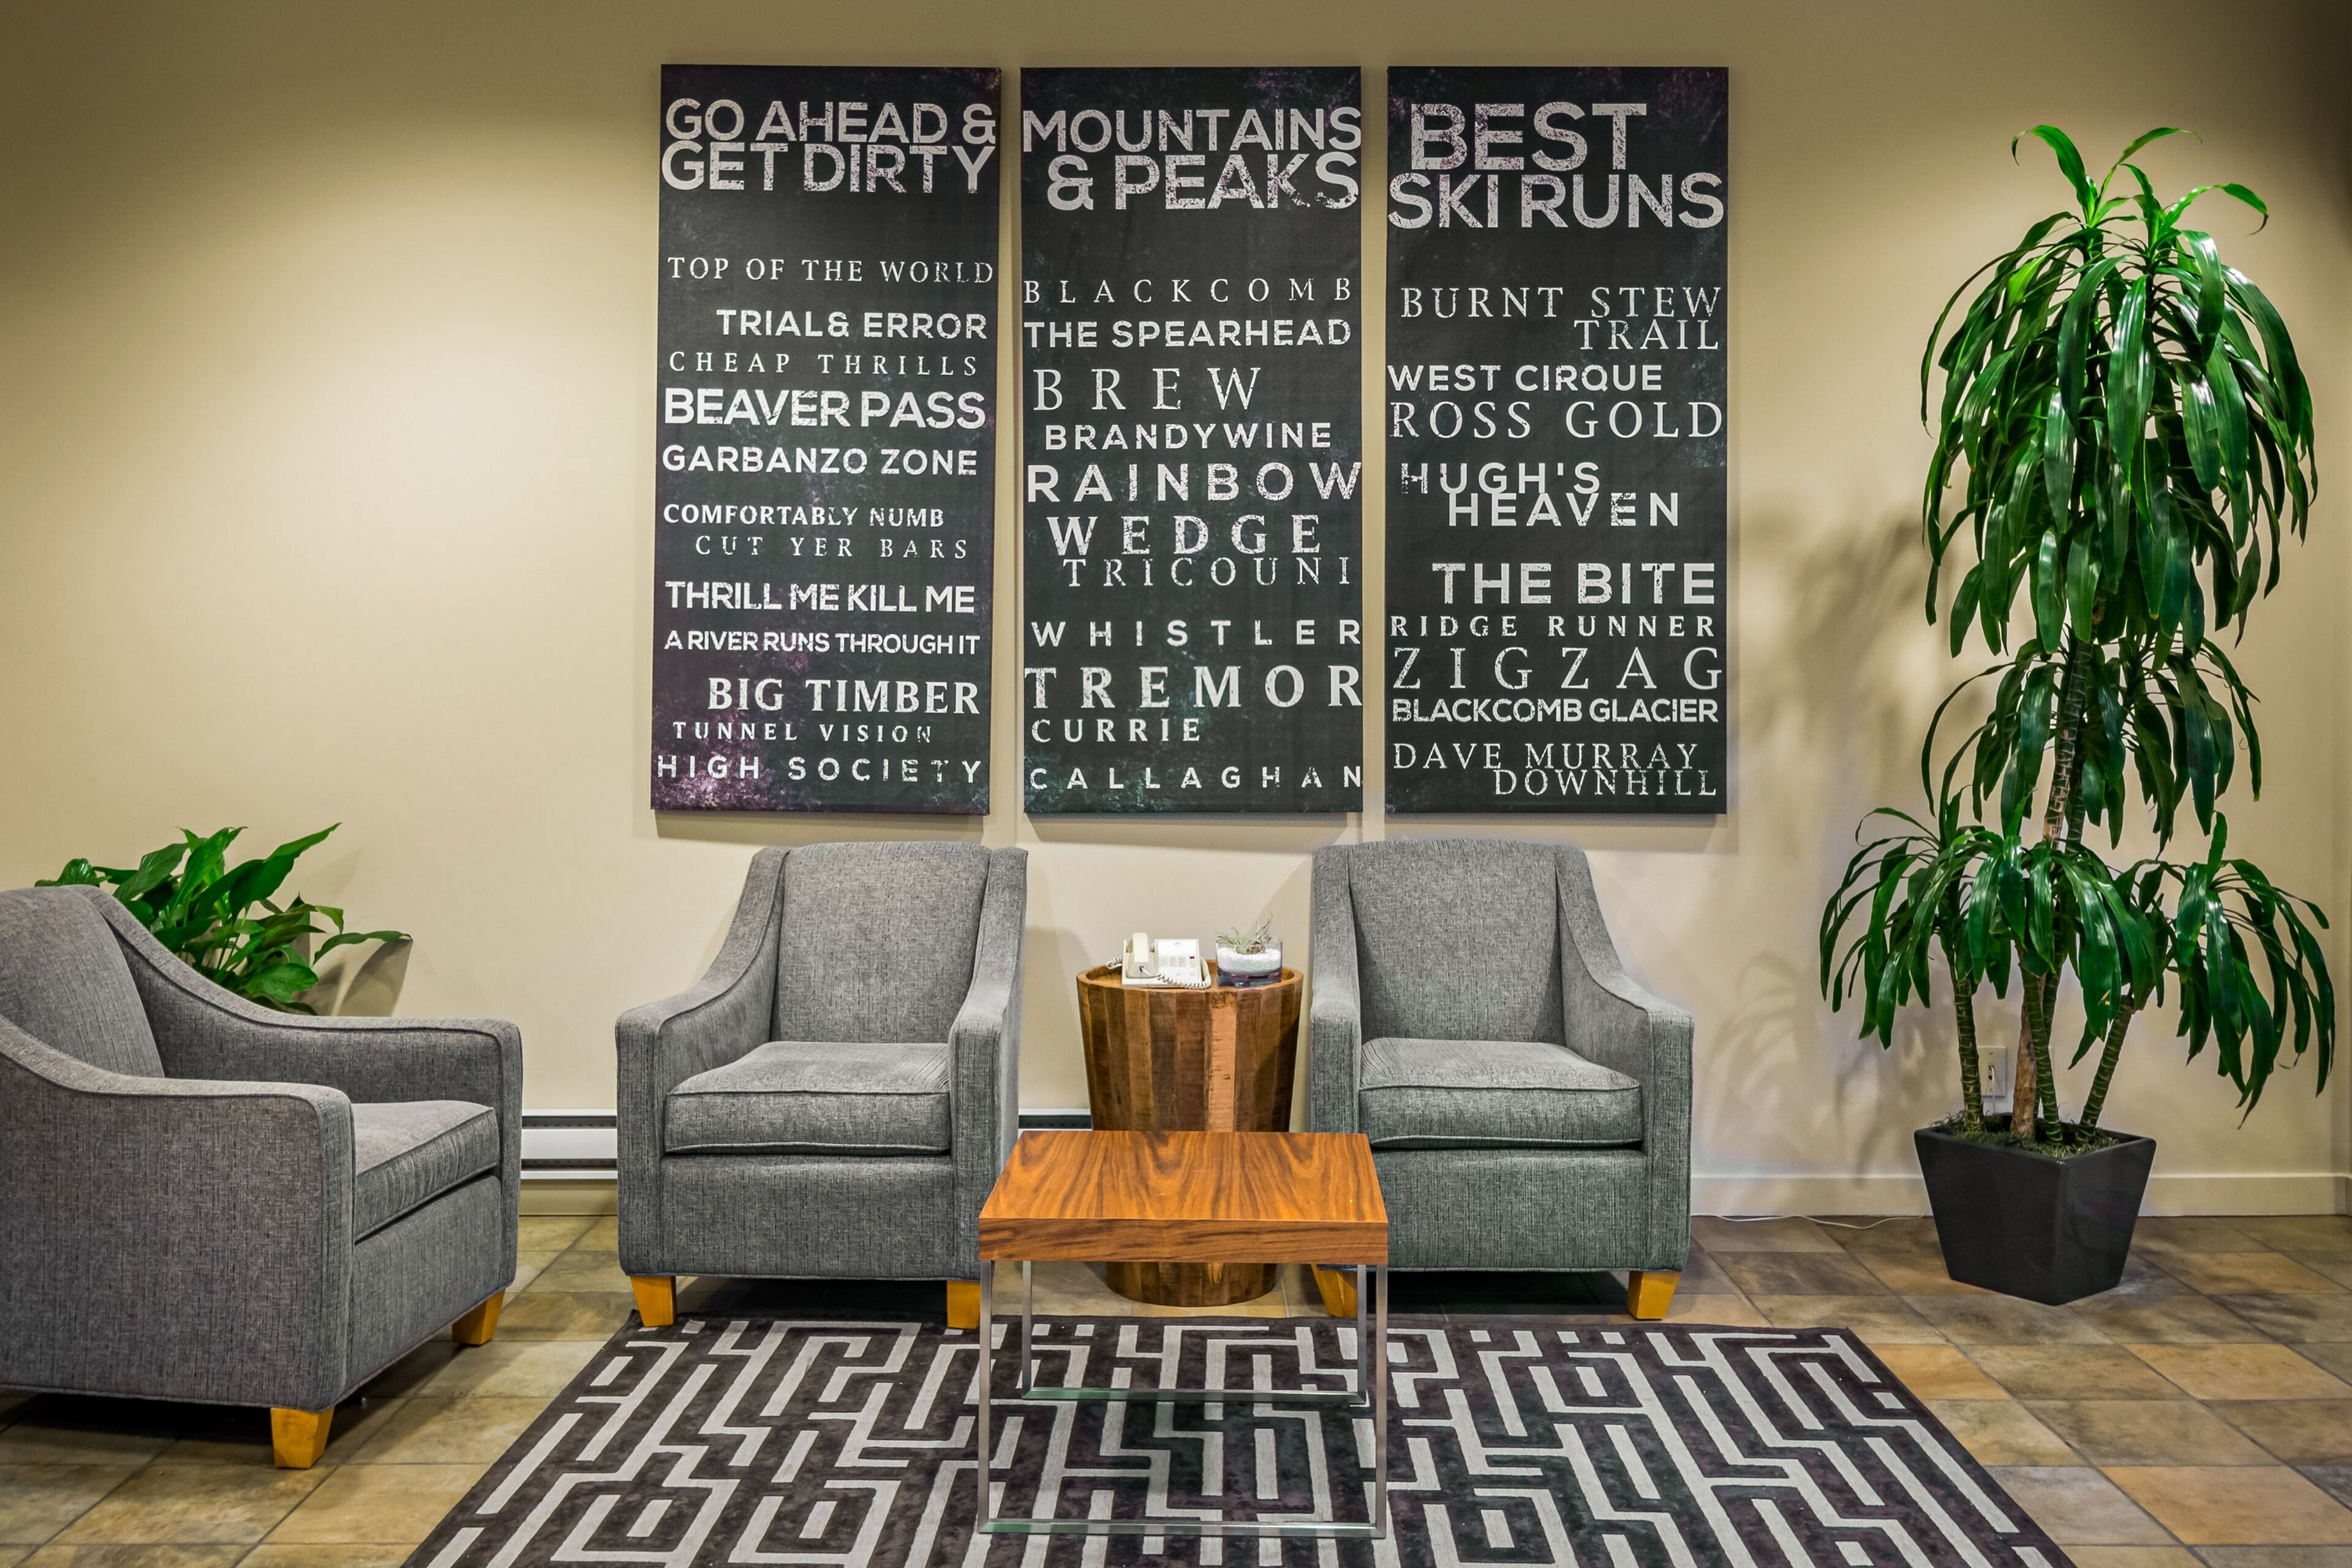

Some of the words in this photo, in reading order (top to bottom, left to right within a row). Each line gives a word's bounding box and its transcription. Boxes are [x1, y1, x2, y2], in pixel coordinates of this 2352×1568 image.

[666, 98, 744, 140] GO
[755, 100, 948, 143] AHEAD
[962, 104, 995, 144] &
[1023, 107, 1361, 153] MOUNTAINS
[1411, 102, 1646, 171] BEST
[662, 140, 788, 190] GET
[804, 143, 995, 194] DIRTY
[1047, 155, 1093, 210] &
[1115, 151, 1359, 210] PEAKS
[1388, 173, 1498, 228] SKI
[1521, 172, 1724, 228] RUNS
[668, 257, 729, 279] TOP
[746, 258, 784, 280] OF
[802, 260, 862, 281] THE
[880, 261, 993, 283] WORLD
[1023, 277, 1350, 303] BLACKCOMB
[1401, 287, 1563, 318] BURNT
[1591, 287, 1721, 317] STEW
[864, 312, 987, 339] ERROR
[1023, 322, 1097, 348] THE
[1112, 319, 1351, 348] SPEARHEAD
[1574, 319, 1718, 350] TRAIL
[669, 352, 790, 372] CHEAP
[818, 354, 976, 376] THRILLS
[1387, 364, 1501, 391] WEST
[1515, 364, 1662, 392] CIRQUE
[1033, 368, 1261, 410] BREW
[665, 388, 851, 427] BEAVER
[861, 391, 986, 429] PASS
[1390, 401, 1531, 439] ROSS
[1566, 401, 1722, 439] GOLD
[1046, 423, 1330, 450] BRANDYWINE
[662, 445, 868, 474] GARBANZO
[881, 448, 977, 475] ZONE
[1028, 462, 1362, 502] RAINBOW
[1401, 462, 1600, 494] HUGH'S
[663, 504, 858, 527] COMFORTABLY
[869, 507, 944, 527] NUMB
[1449, 492, 1678, 527] HEAVEN
[696, 536, 763, 556] CUT
[791, 538, 853, 557] YER
[881, 539, 967, 559] BARS
[1046, 514, 1319, 556] WEDGE
[1063, 557, 1350, 587] TRICOUNI
[1432, 563, 1551, 604] THE
[1578, 563, 1715, 604] BITE
[665, 581, 782, 610] THRILL
[790, 583, 839, 611] ME
[848, 584, 916, 612] KILL
[925, 586, 975, 612] ME
[1031, 620, 1361, 647] WHISTLER
[1390, 616, 1517, 637] RIDGE
[1548, 616, 1714, 637] RUNNER
[664, 630, 684, 649] A
[688, 631, 759, 650] RIVER
[764, 632, 830, 652] RUNS
[835, 633, 953, 654] THROUGH
[959, 635, 980, 654] IT
[707, 677, 784, 710] BIG
[805, 679, 980, 714] TIMBER
[1024, 665, 1362, 709] TREMOR
[1393, 698, 1582, 722] BLACKCOMB
[1589, 698, 1719, 722] GLACIER
[673, 722, 797, 741] TUNNEL
[820, 724, 931, 744] VISION
[1031, 718, 1199, 742] CURRIE
[658, 755, 759, 779] HIGH
[788, 757, 981, 783] SOCIETY
[1393, 742, 1501, 769] DAVE
[1525, 743, 1698, 769] MURRAY
[1030, 766, 1362, 790] CALLAGHAN
[1493, 769, 1716, 796] DOWNHILL
